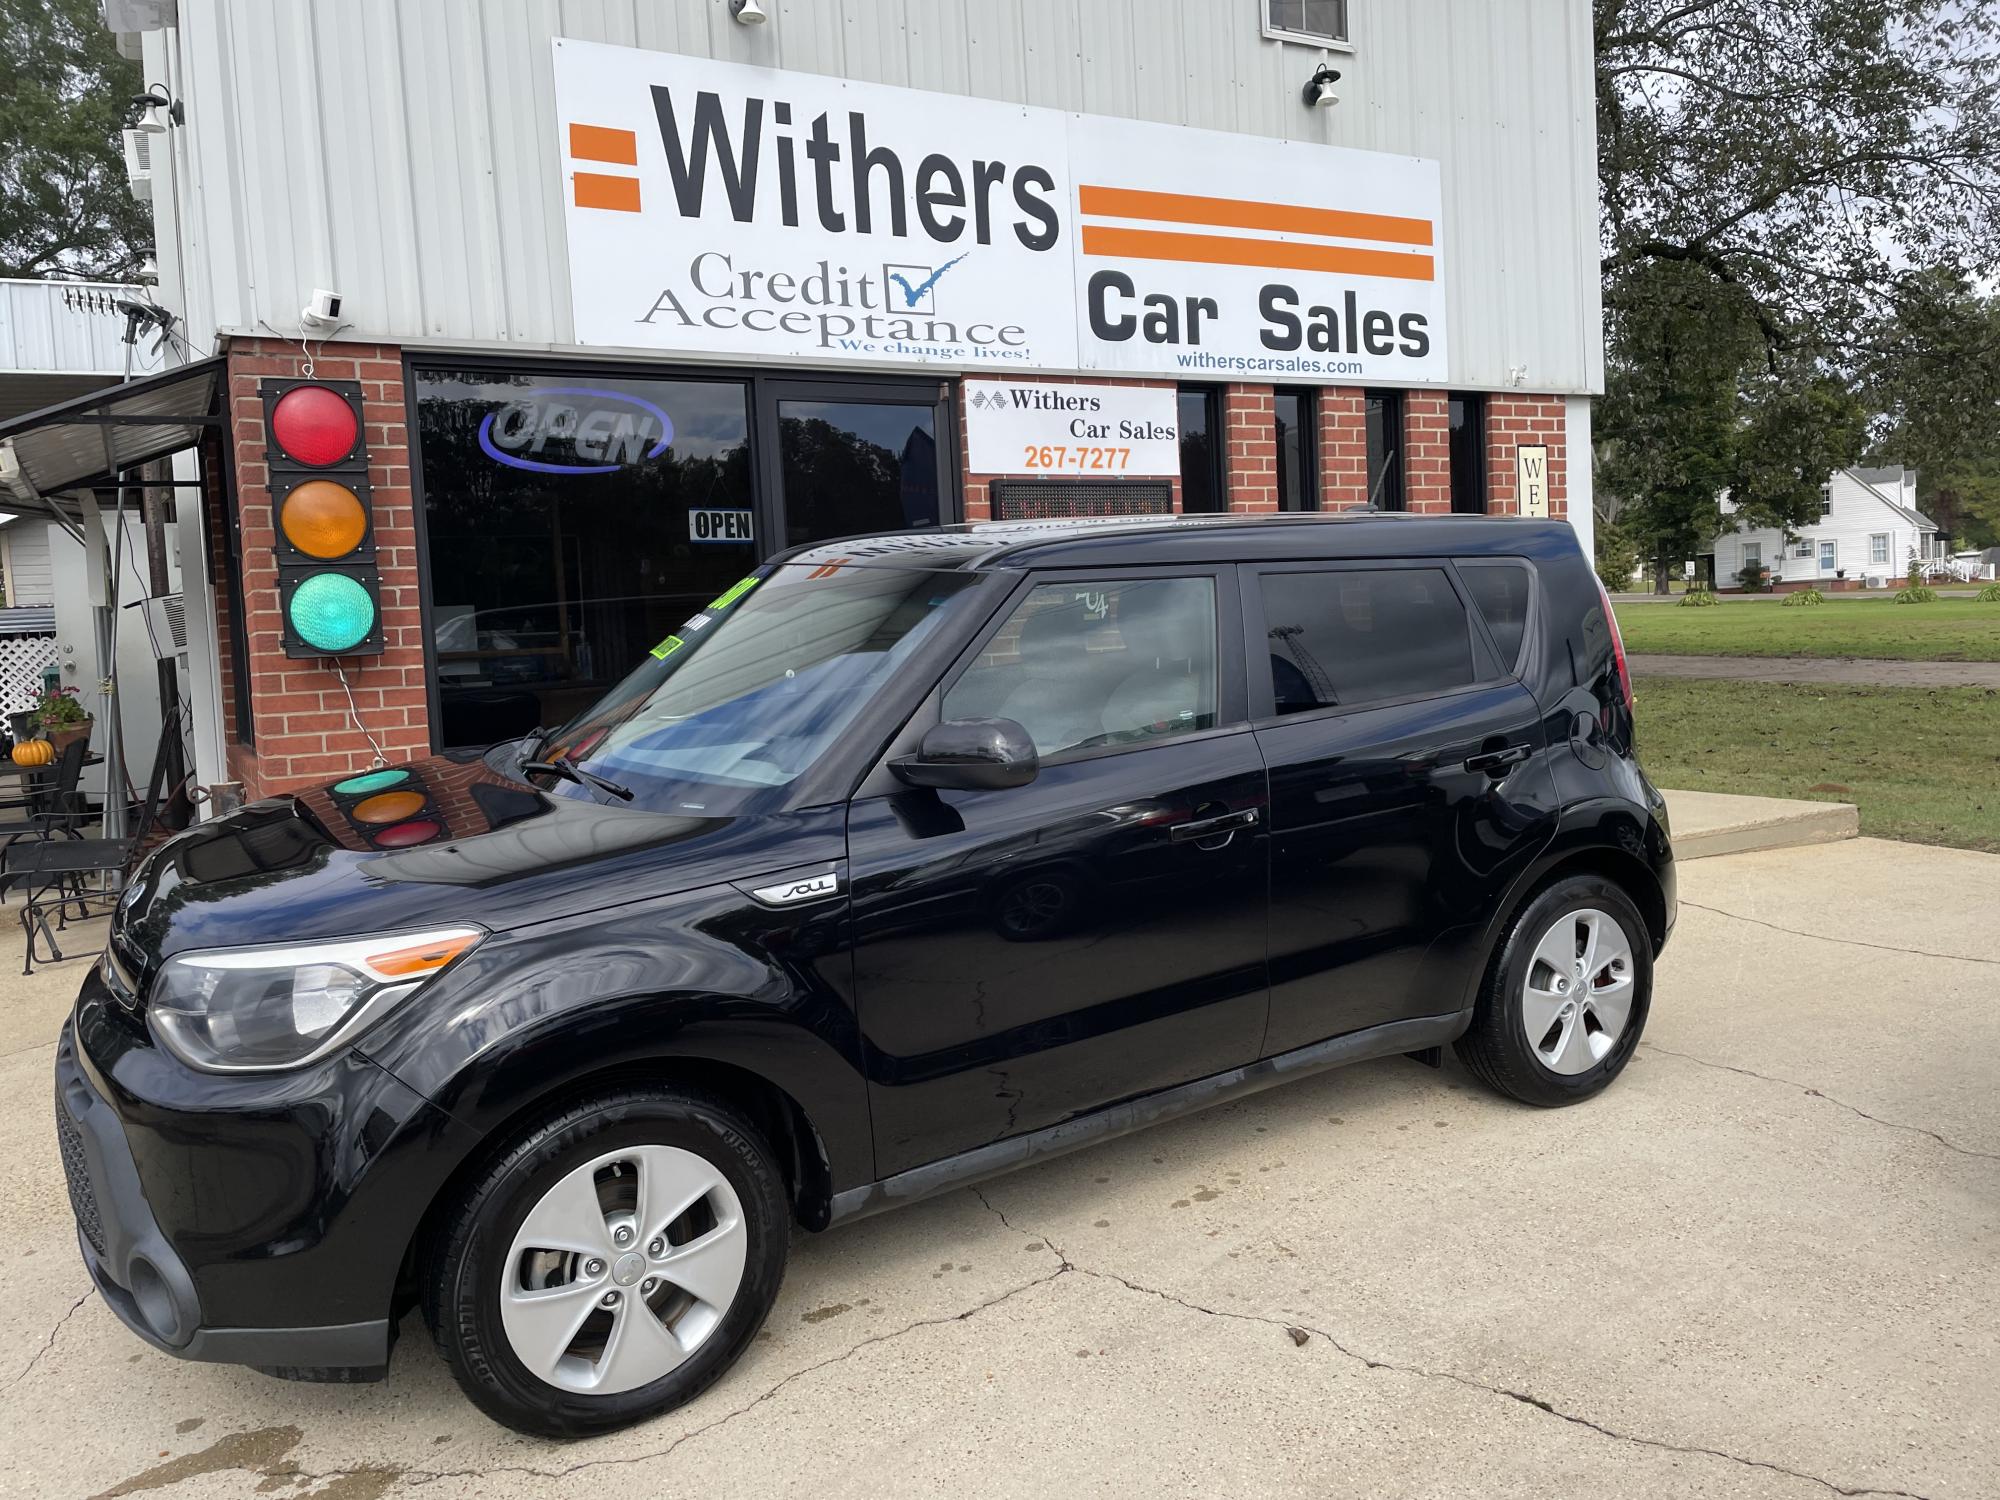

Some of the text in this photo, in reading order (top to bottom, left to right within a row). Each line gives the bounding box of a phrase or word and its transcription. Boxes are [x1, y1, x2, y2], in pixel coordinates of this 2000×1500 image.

[649, 84, 1060, 252] Withers
[690, 251, 879, 310] Credit
[634, 288, 1027, 348] Acceptance
[1087, 269, 1431, 358] Car Sales
[838, 338, 1031, 360] We change lives!
[1176, 351, 1363, 374] witherscarsales.com
[1009, 388, 1101, 412] Withers
[492, 401, 655, 465] OPEN
[1069, 418, 1176, 441] Car Sales
[1024, 445, 1131, 469] 267-7277
[695, 511, 751, 539] OPEN
